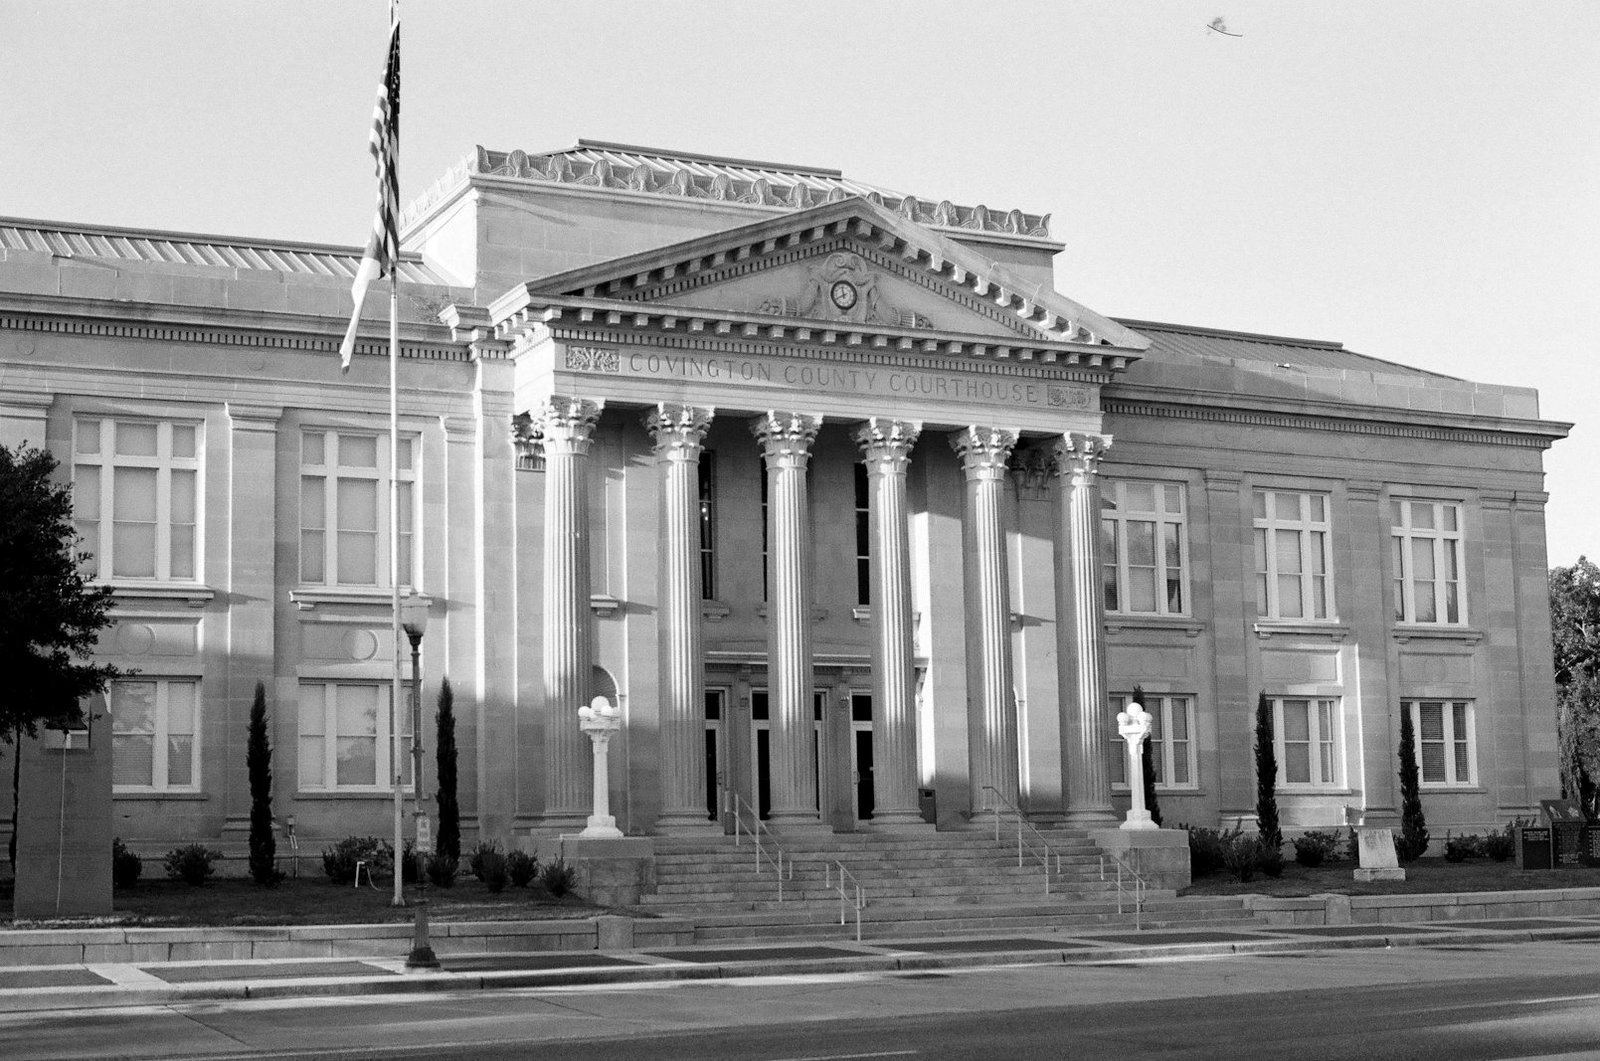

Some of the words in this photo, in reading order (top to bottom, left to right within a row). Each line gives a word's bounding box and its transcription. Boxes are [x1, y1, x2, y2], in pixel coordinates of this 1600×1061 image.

[630, 353, 771, 382] COVINGTON
[784, 364, 876, 390] COUNTY
[889, 374, 1038, 403] COURTHOUSE
